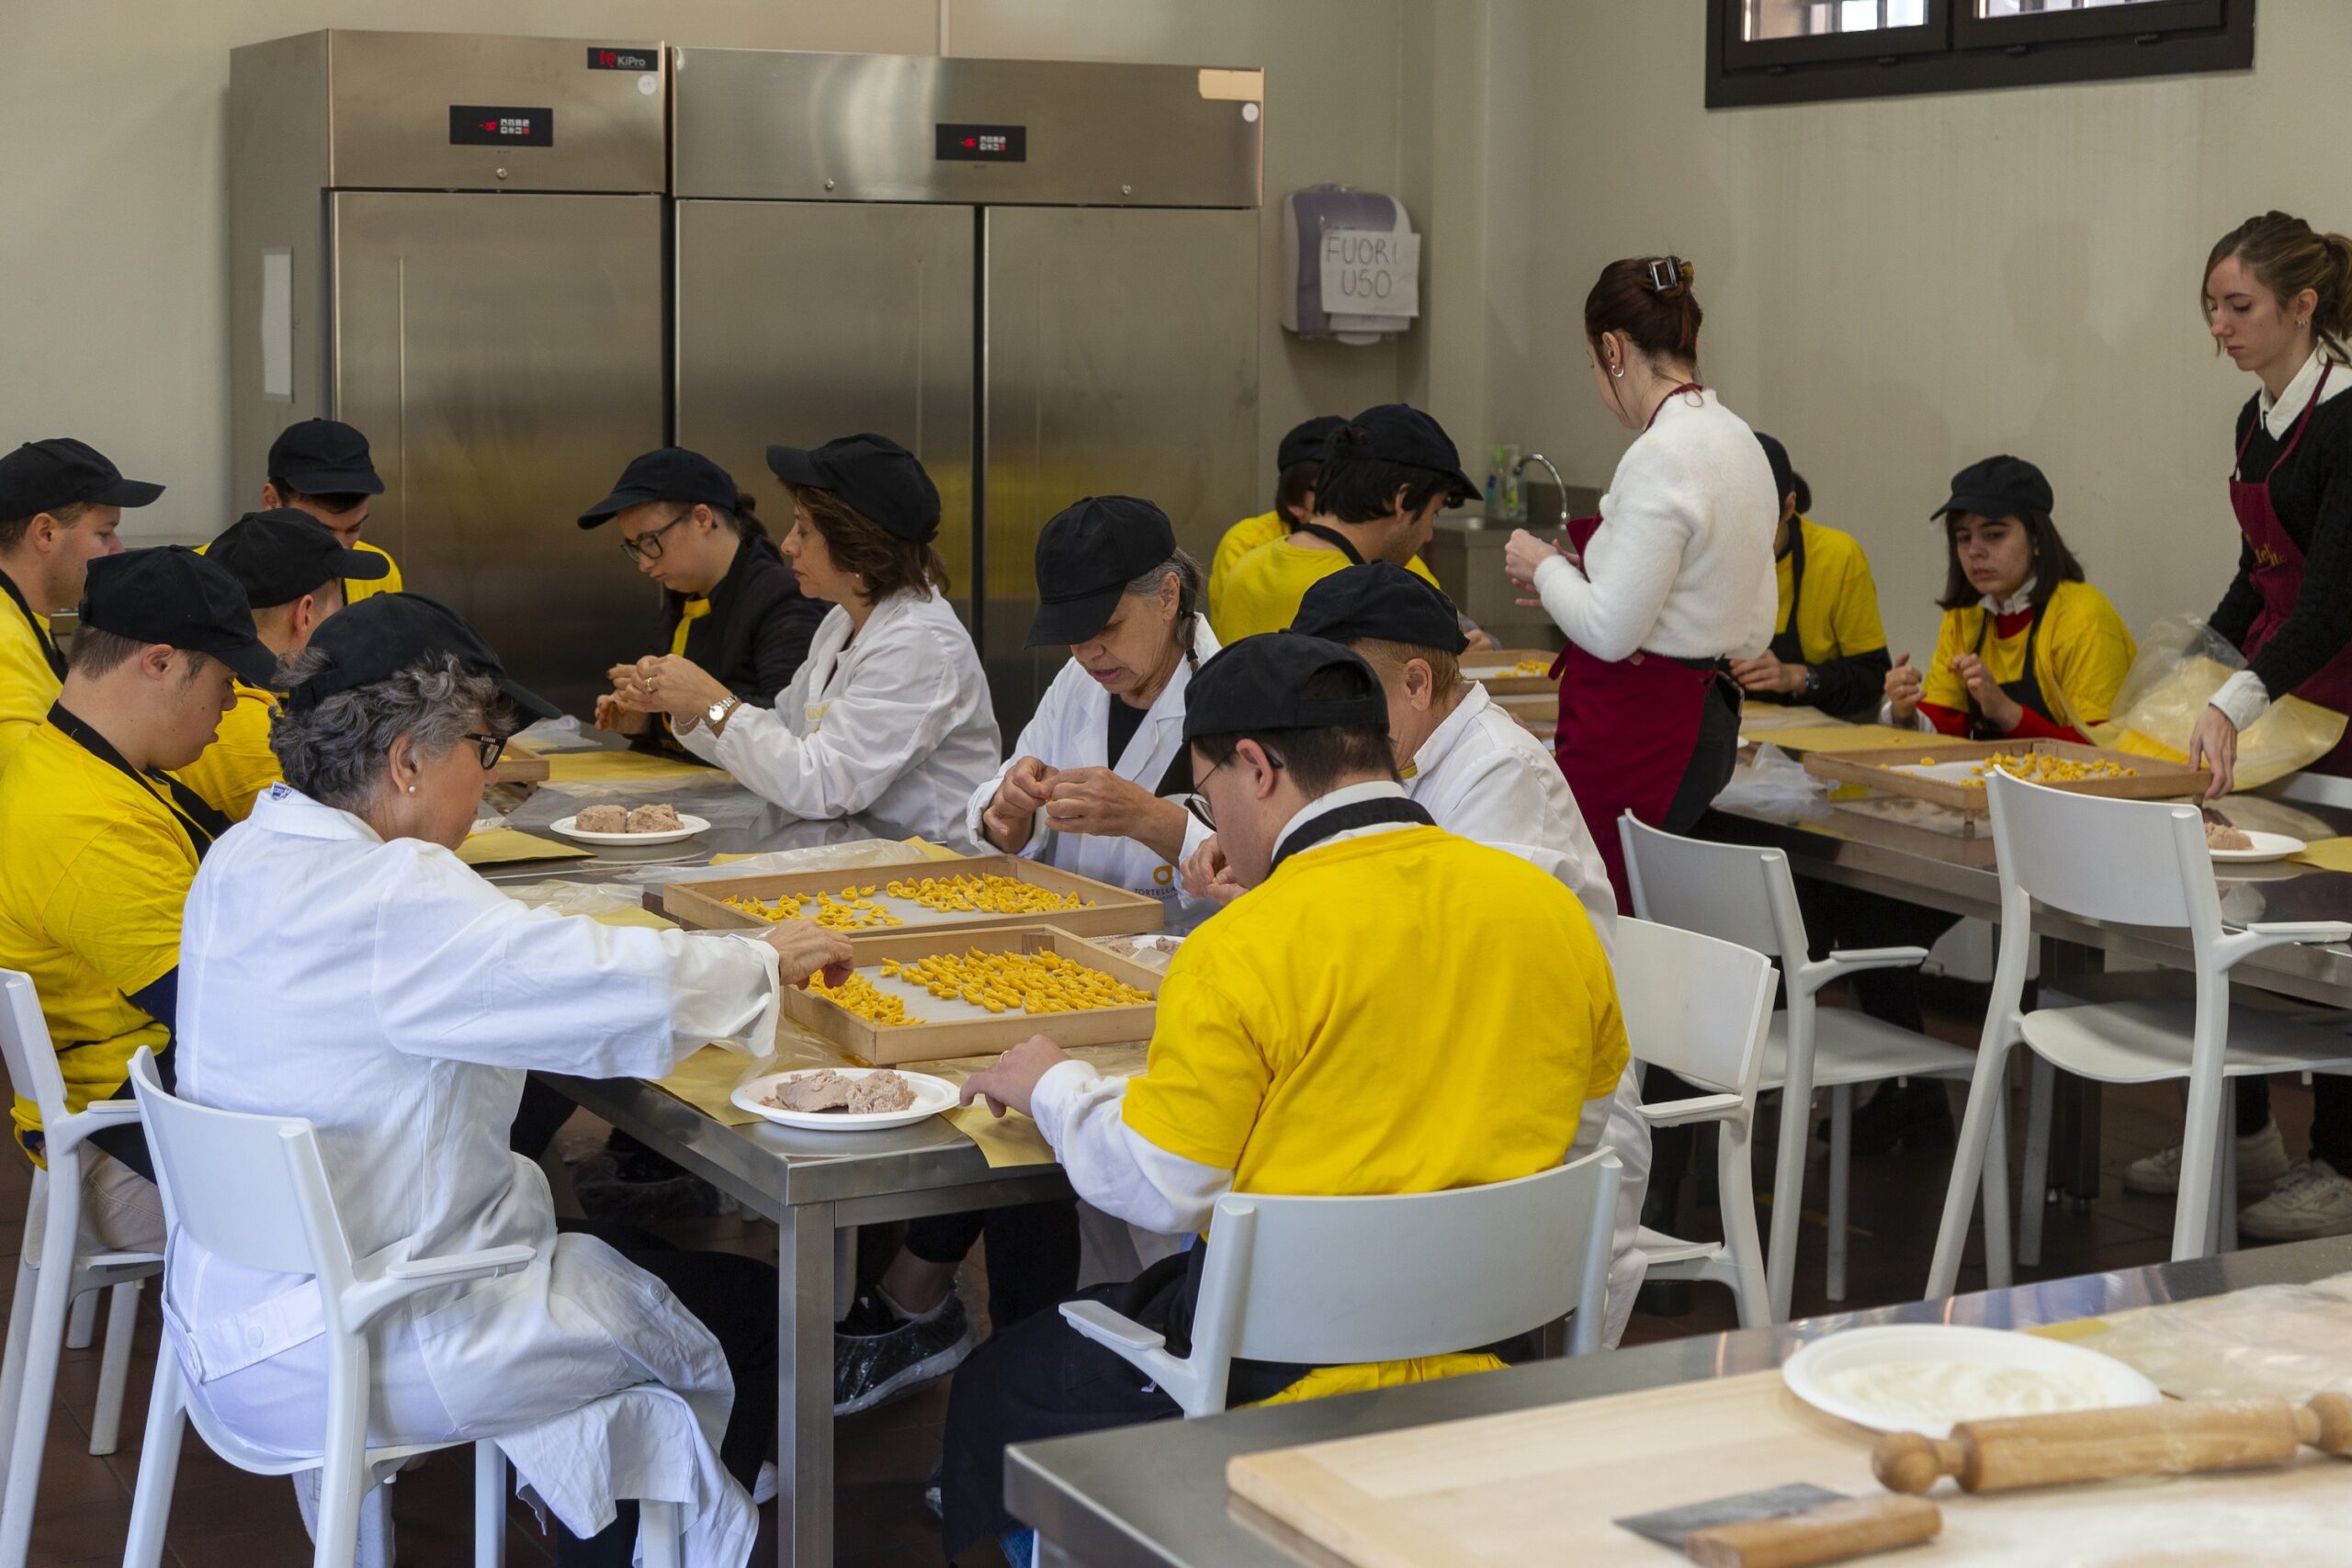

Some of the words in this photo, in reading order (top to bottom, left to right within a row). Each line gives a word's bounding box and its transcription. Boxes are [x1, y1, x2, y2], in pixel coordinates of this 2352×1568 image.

[616, 56, 646, 67] KiPro
[1327, 237, 1397, 265] FUORI
[1341, 268, 1393, 299] USO
[1135, 886, 1177, 897] TORTELLA
